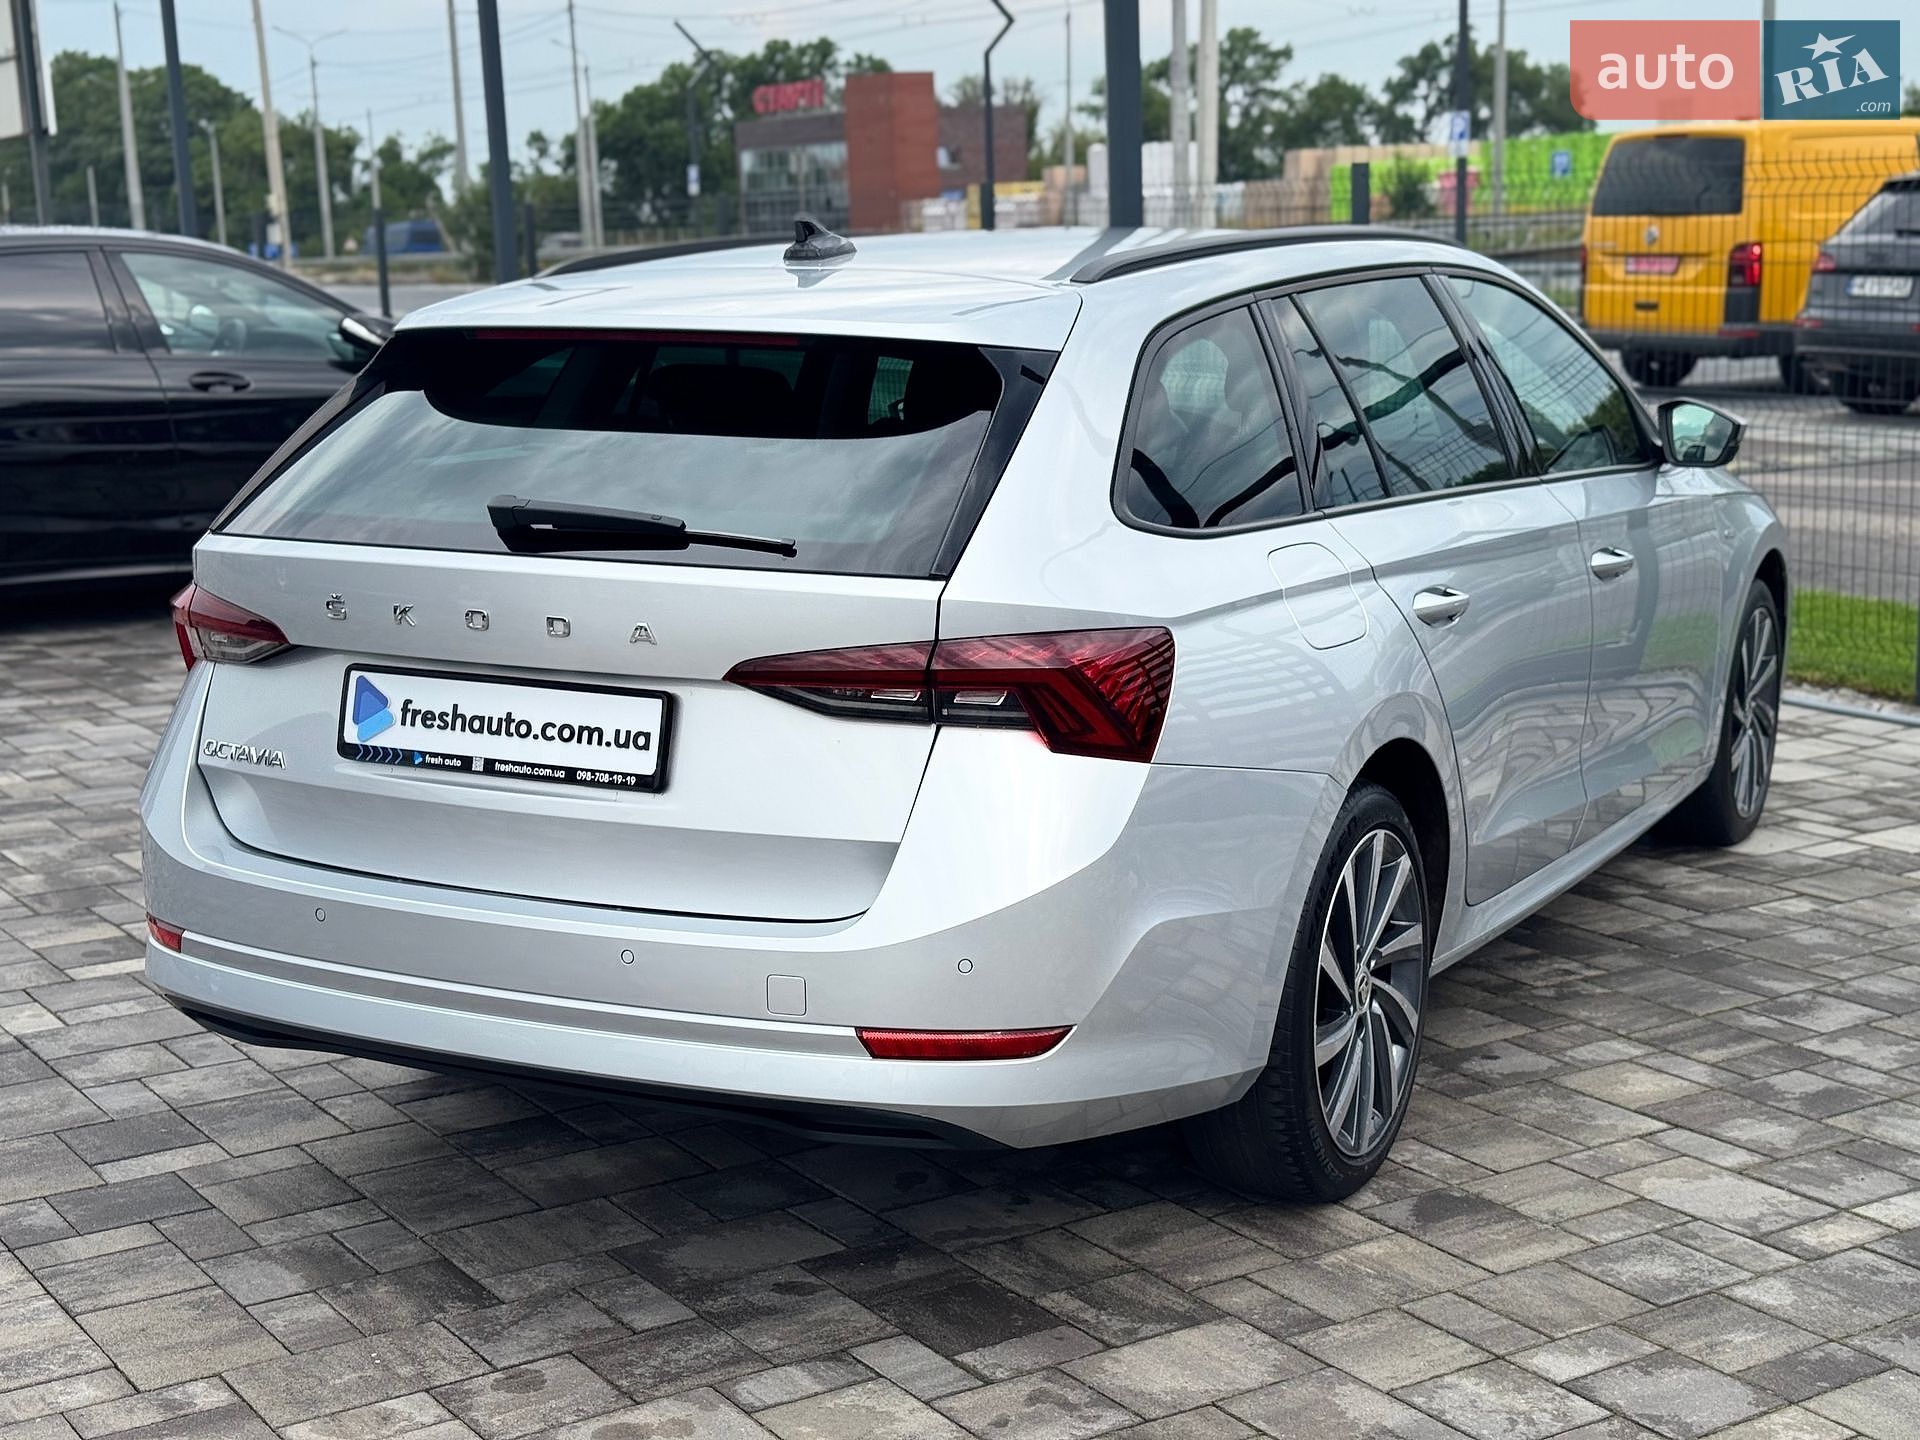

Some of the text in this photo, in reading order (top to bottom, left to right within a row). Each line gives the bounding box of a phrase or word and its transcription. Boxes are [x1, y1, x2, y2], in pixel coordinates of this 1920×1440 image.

[325, 592, 658, 646] ŠKODA
[400, 699, 652, 751] freshauto.com.ua
[203, 739, 287, 770] OCTAVIA
[425, 754, 462, 768] fresh auto
[494, 761, 566, 779] freshauto.com.ua
[576, 770, 636, 786] 098-708-19-19
